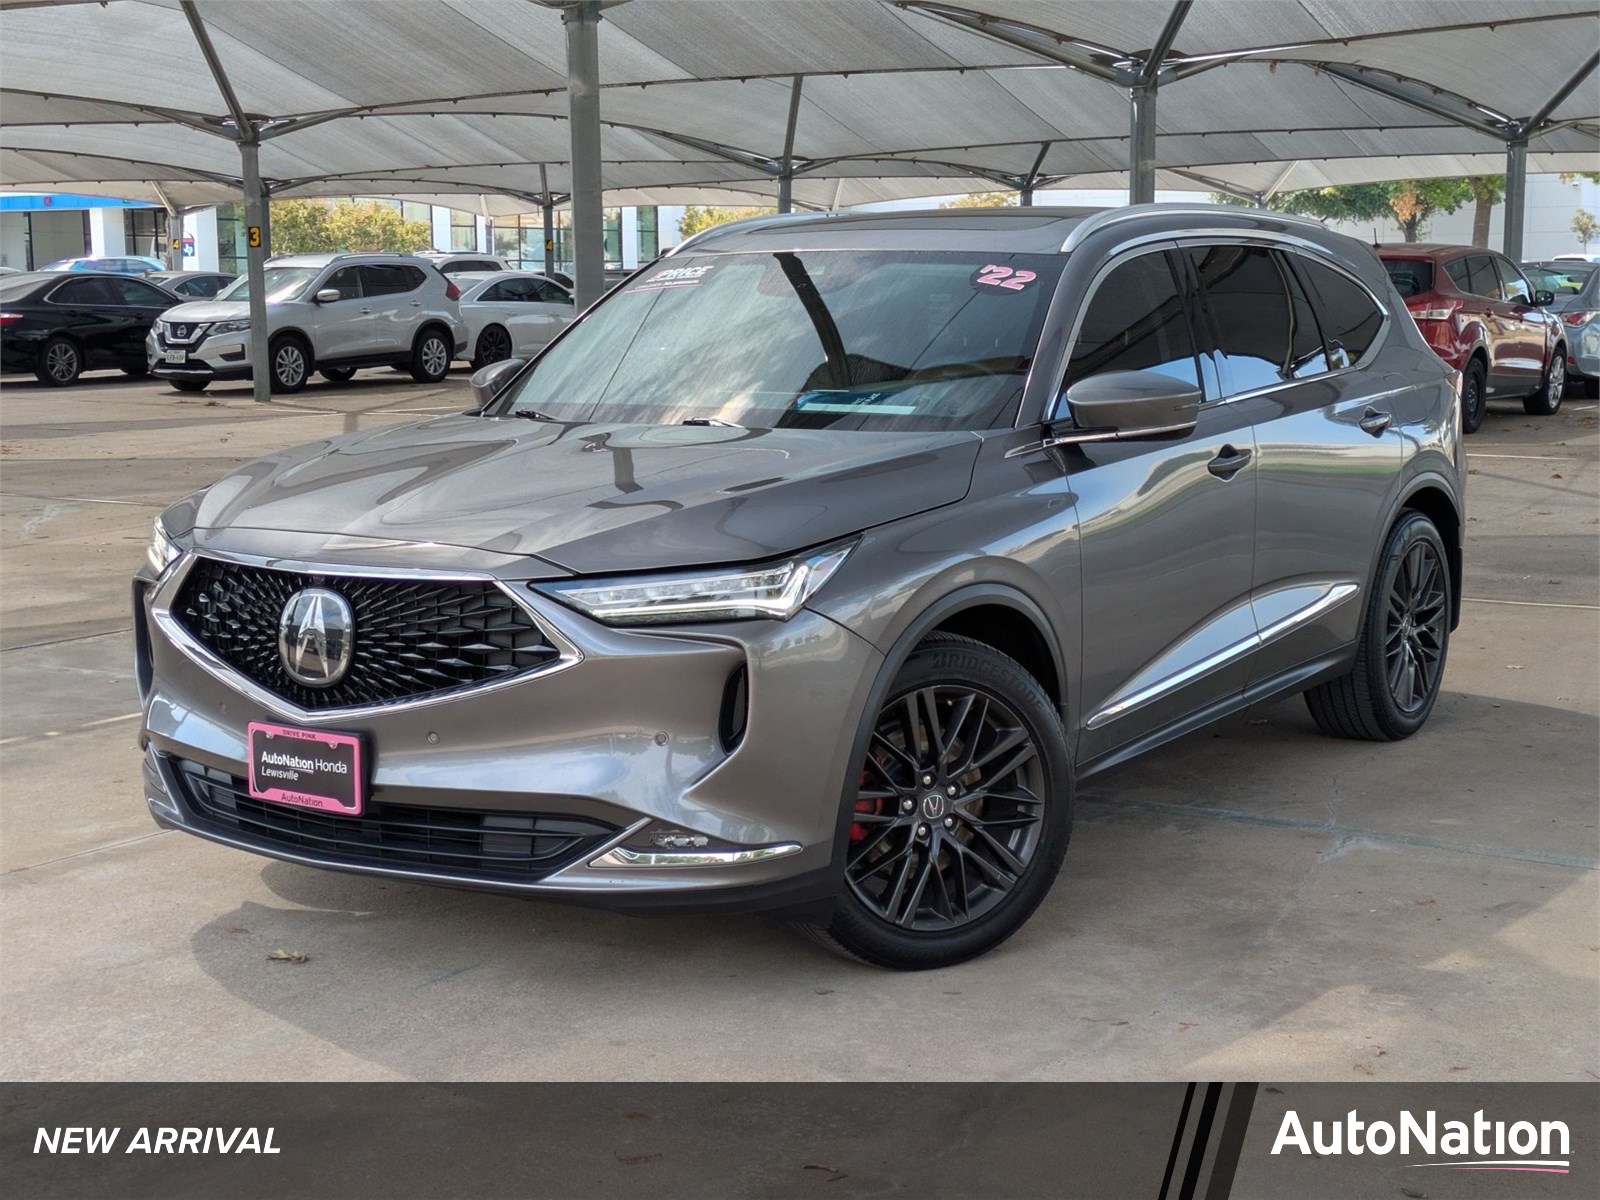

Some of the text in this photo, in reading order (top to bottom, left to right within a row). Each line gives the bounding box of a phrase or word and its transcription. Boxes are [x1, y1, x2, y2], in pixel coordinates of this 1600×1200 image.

[173, 239, 179, 249] 4
[249, 226, 261, 247] 3
[282, 729, 316, 740] DRIVE PINK
[261, 750, 348, 774] AutoNation Honda
[261, 765, 299, 781] Lewisville
[281, 792, 324, 808] AutoNation
